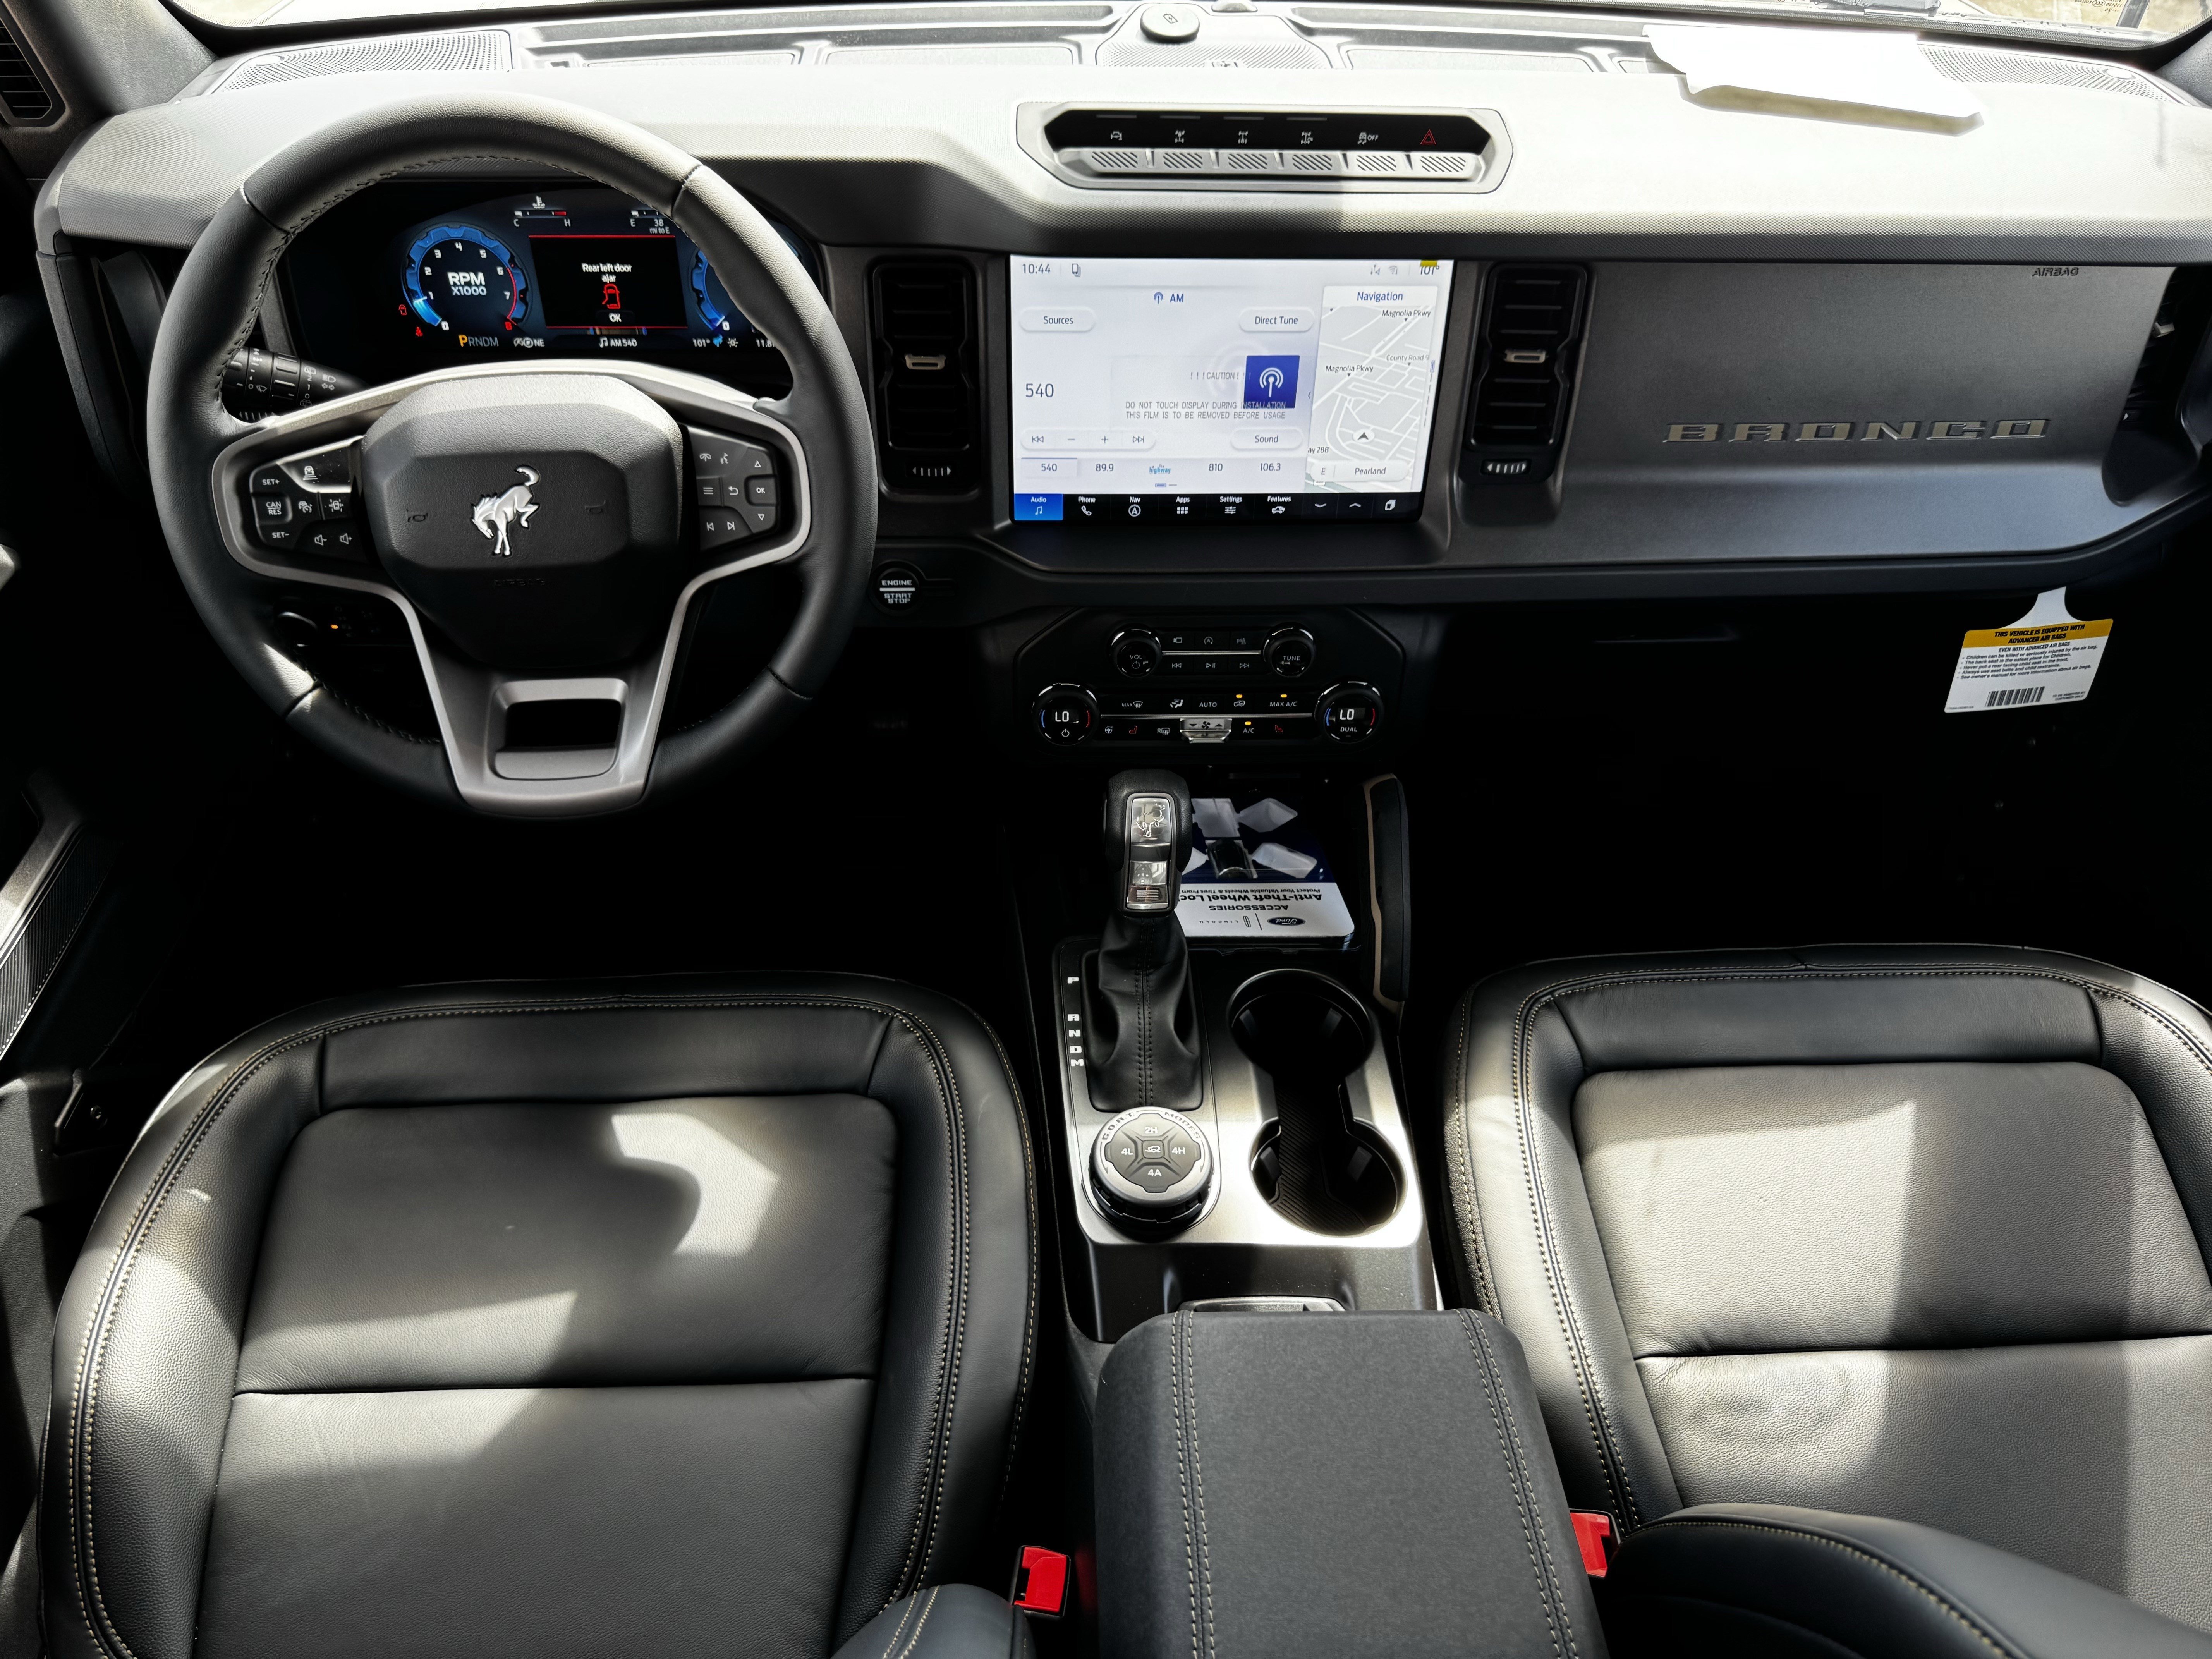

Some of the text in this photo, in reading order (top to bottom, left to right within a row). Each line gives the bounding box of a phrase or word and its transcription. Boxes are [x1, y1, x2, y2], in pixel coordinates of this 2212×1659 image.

[455, 242, 462, 251] 4
[434, 249, 441, 258] 3
[479, 249, 487, 258] 5
[424, 267, 432, 275] 2
[496, 267, 504, 275] 6
[581, 263, 632, 272] Rear left door
[1022, 263, 1051, 274] 10:44
[2032, 267, 2079, 276] AIRBAG
[447, 272, 485, 285] RPM
[601, 273, 616, 283] ajar
[452, 286, 487, 295] X1000
[428, 291, 434, 300] 1
[504, 291, 510, 300] 7
[1170, 294, 1184, 302] AM
[1357, 292, 1403, 302] Navigation
[609, 313, 622, 322] OK
[1044, 316, 1073, 325] Sources
[1255, 316, 1298, 325] Direct Tune
[441, 321, 449, 330] 0
[534, 338, 545, 347] NE
[610, 338, 637, 347] AM 540
[1326, 365, 1355, 373] Magnolia
[1026, 383, 1054, 398] 540
[1126, 401, 1286, 409] DO NOT TOUCH DISPLAY DURING INSTALLATION
[1662, 419, 2049, 443] BRONCO
[1255, 434, 1278, 443] Sound
[1041, 464, 1057, 472] 540
[1096, 464, 1114, 472] 89.9
[1209, 463, 1223, 472] 810
[1260, 463, 1281, 471] 106.3
[1176, 496, 1190, 504] Apps
[1219, 495, 1242, 504] Settings
[2041, 626, 2069, 634] EQUIPPED
[1055, 711, 1069, 722] LO
[1340, 709, 1354, 720] LO
[1164, 1111, 1200, 1139] MODES
